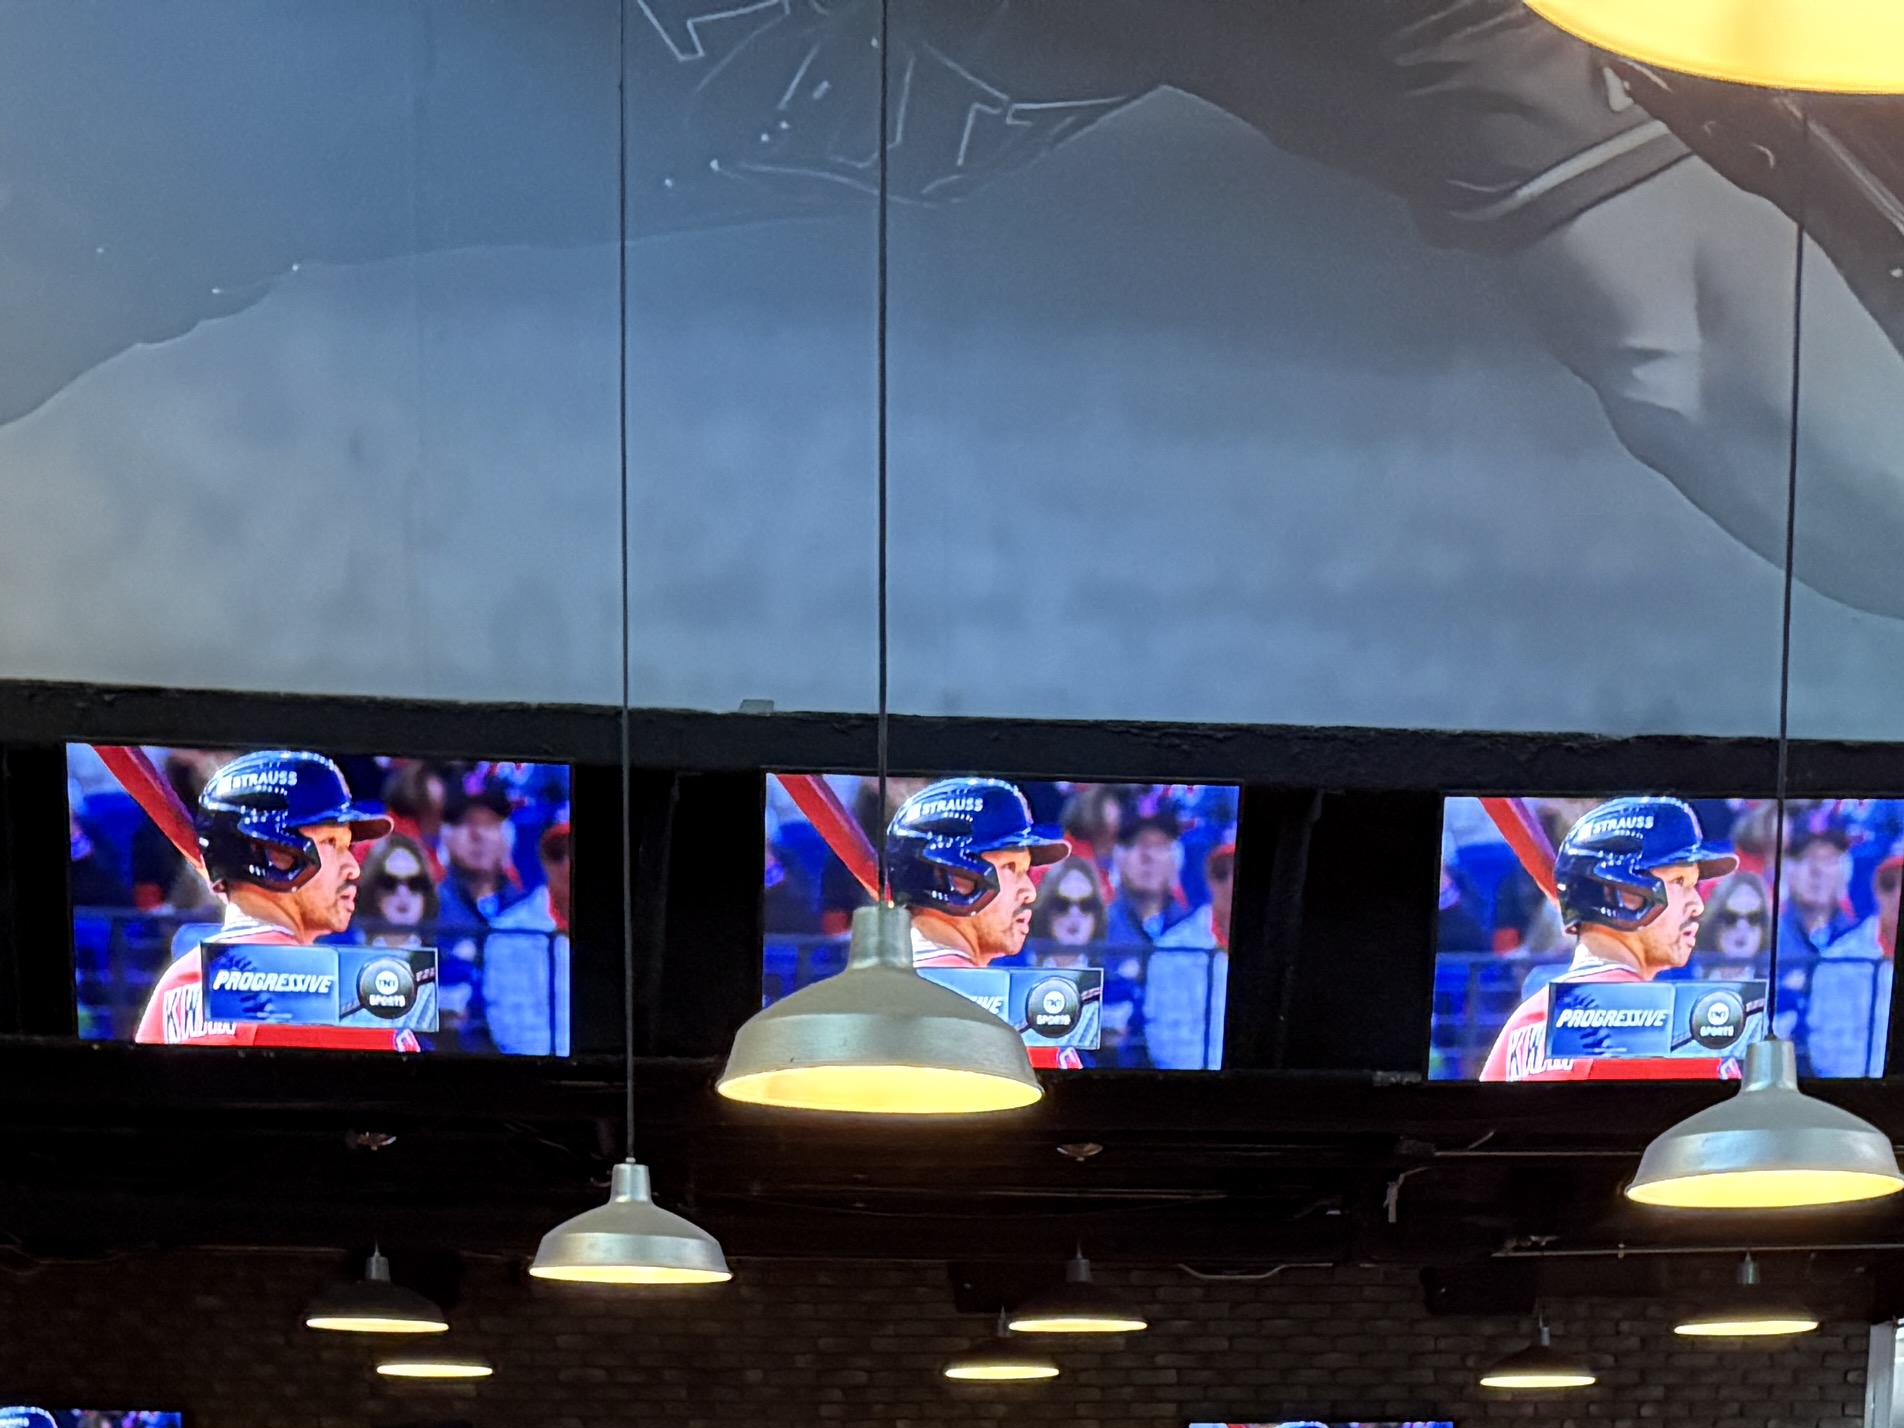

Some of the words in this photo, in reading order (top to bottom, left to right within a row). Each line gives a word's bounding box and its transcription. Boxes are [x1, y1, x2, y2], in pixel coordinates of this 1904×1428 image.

[232, 772, 297, 787] STRAUSS
[921, 798, 983, 814] STRAUSS
[1592, 815, 1654, 834] STRAUSS
[213, 969, 336, 994] PROGRESSIVE
[1556, 1008, 1669, 1028] PROGRESSIVE
